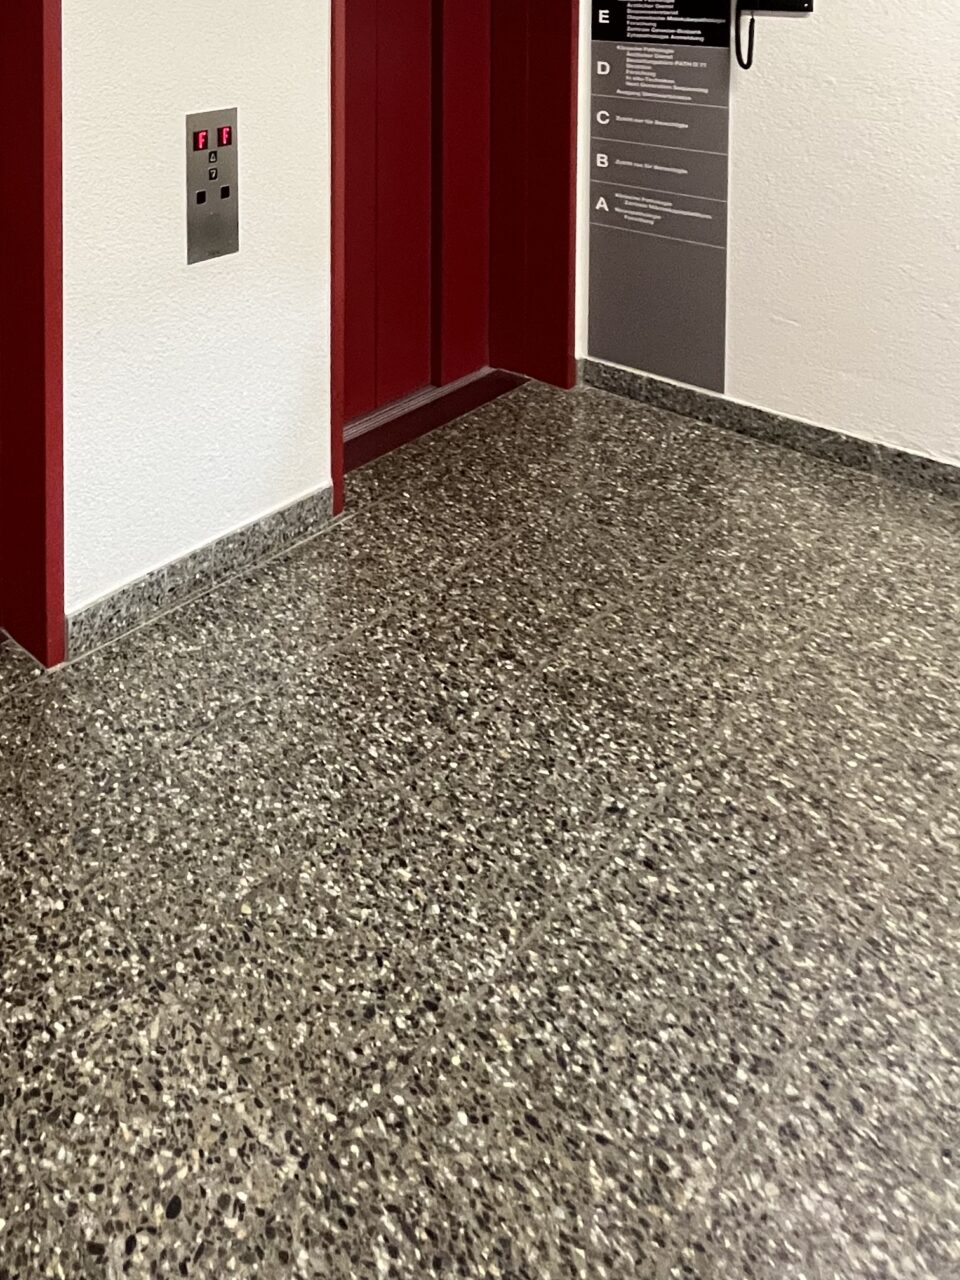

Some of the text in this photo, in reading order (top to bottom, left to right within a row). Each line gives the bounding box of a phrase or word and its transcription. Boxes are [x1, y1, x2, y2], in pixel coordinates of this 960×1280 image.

[599, 10, 609, 23] E
[597, 61, 610, 74] D
[597, 111, 609, 124] C
[199, 128, 229, 148] F F
[597, 154, 608, 167] B
[596, 197, 608, 211] A
